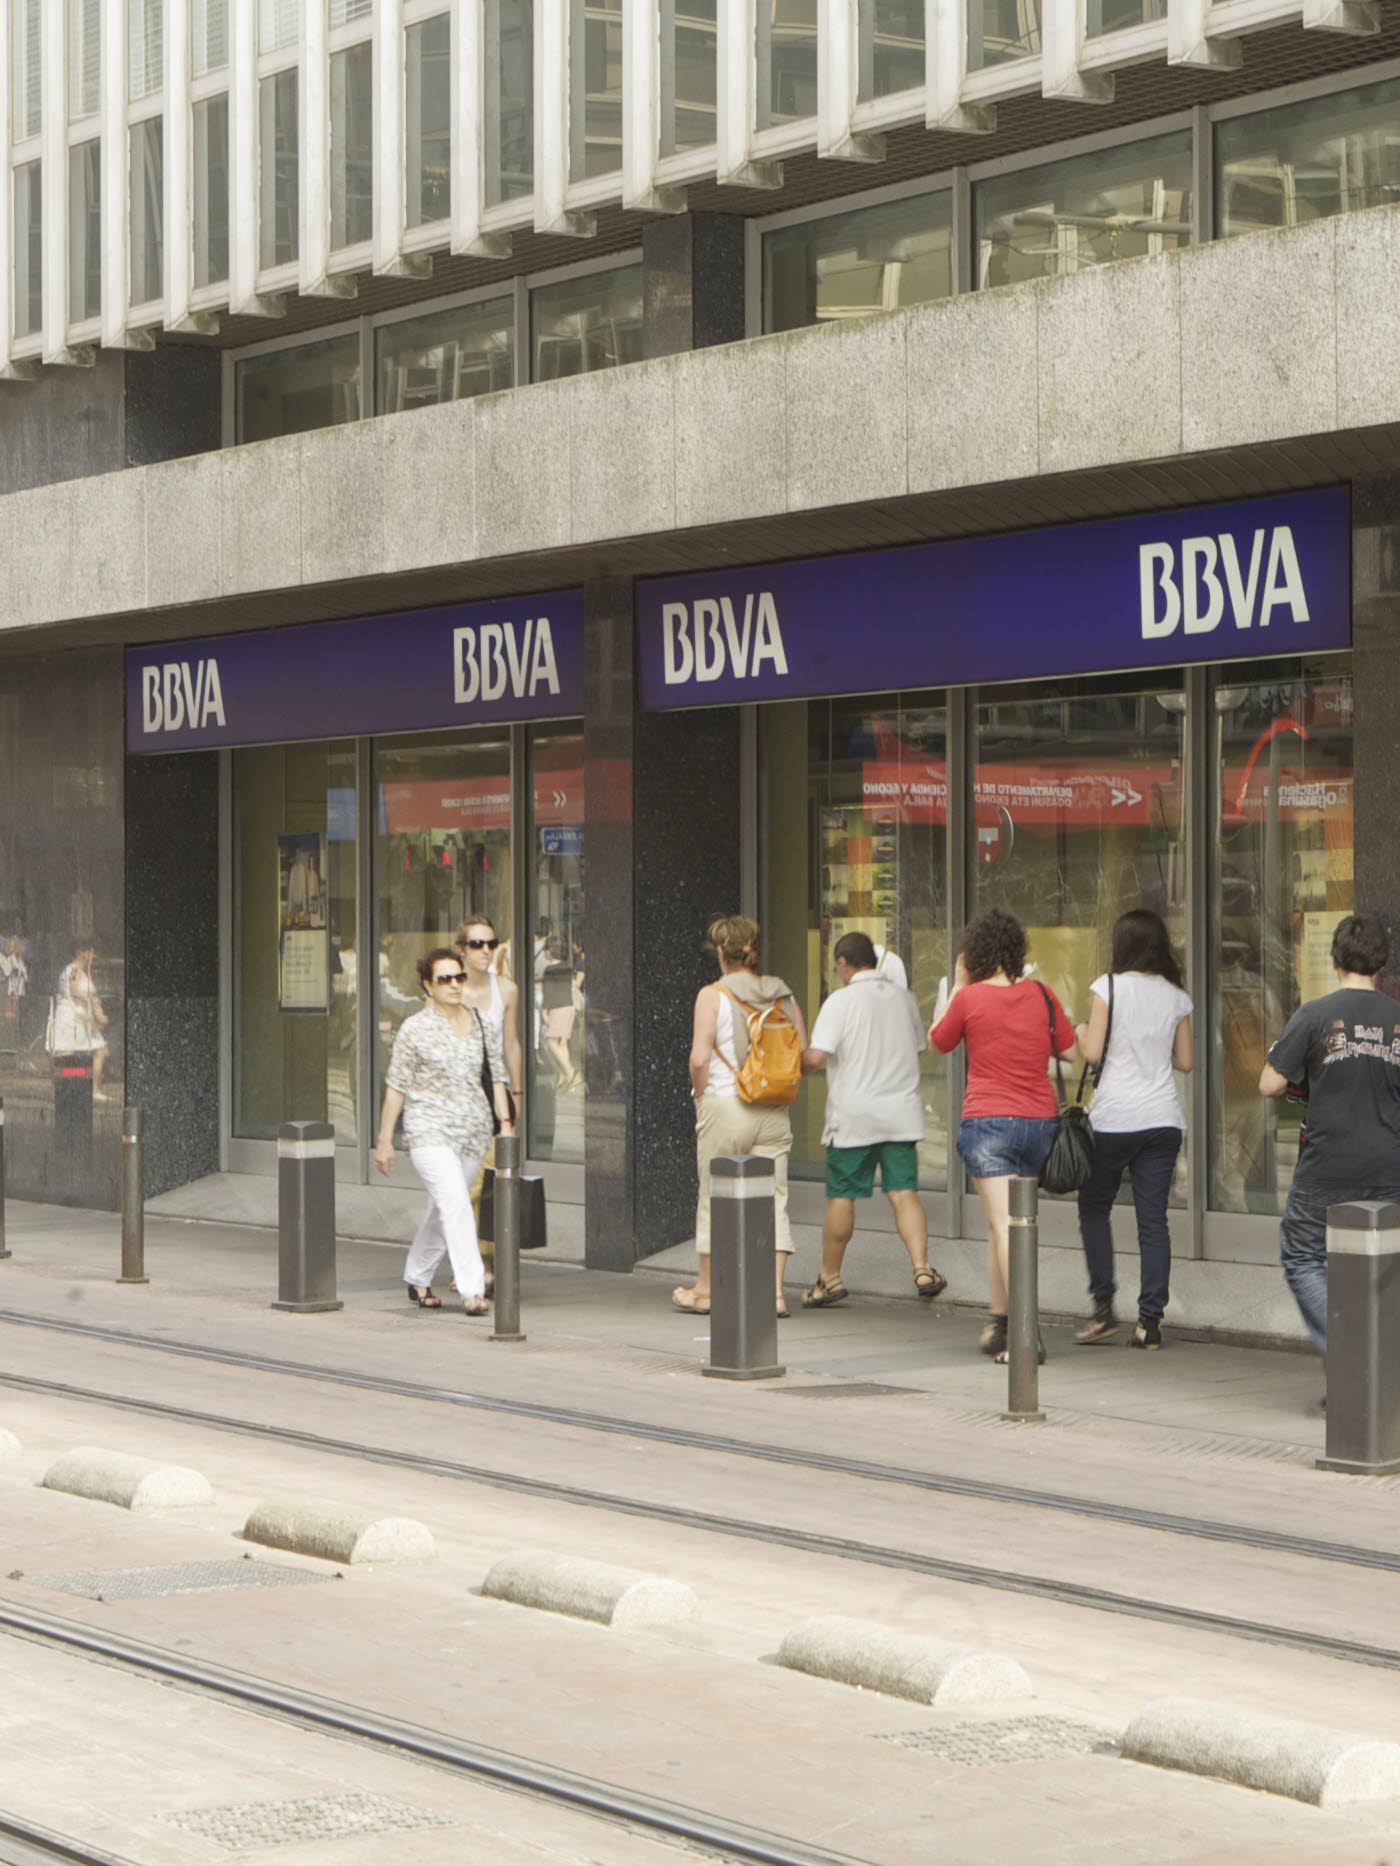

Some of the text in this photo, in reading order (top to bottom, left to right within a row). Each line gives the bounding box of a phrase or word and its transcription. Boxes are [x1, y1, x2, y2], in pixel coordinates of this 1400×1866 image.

[1139, 525, 1310, 640] BBVA
[453, 617, 561, 704] BBVA
[662, 592, 789, 685] BBVA
[142, 658, 226, 733] BBVA
